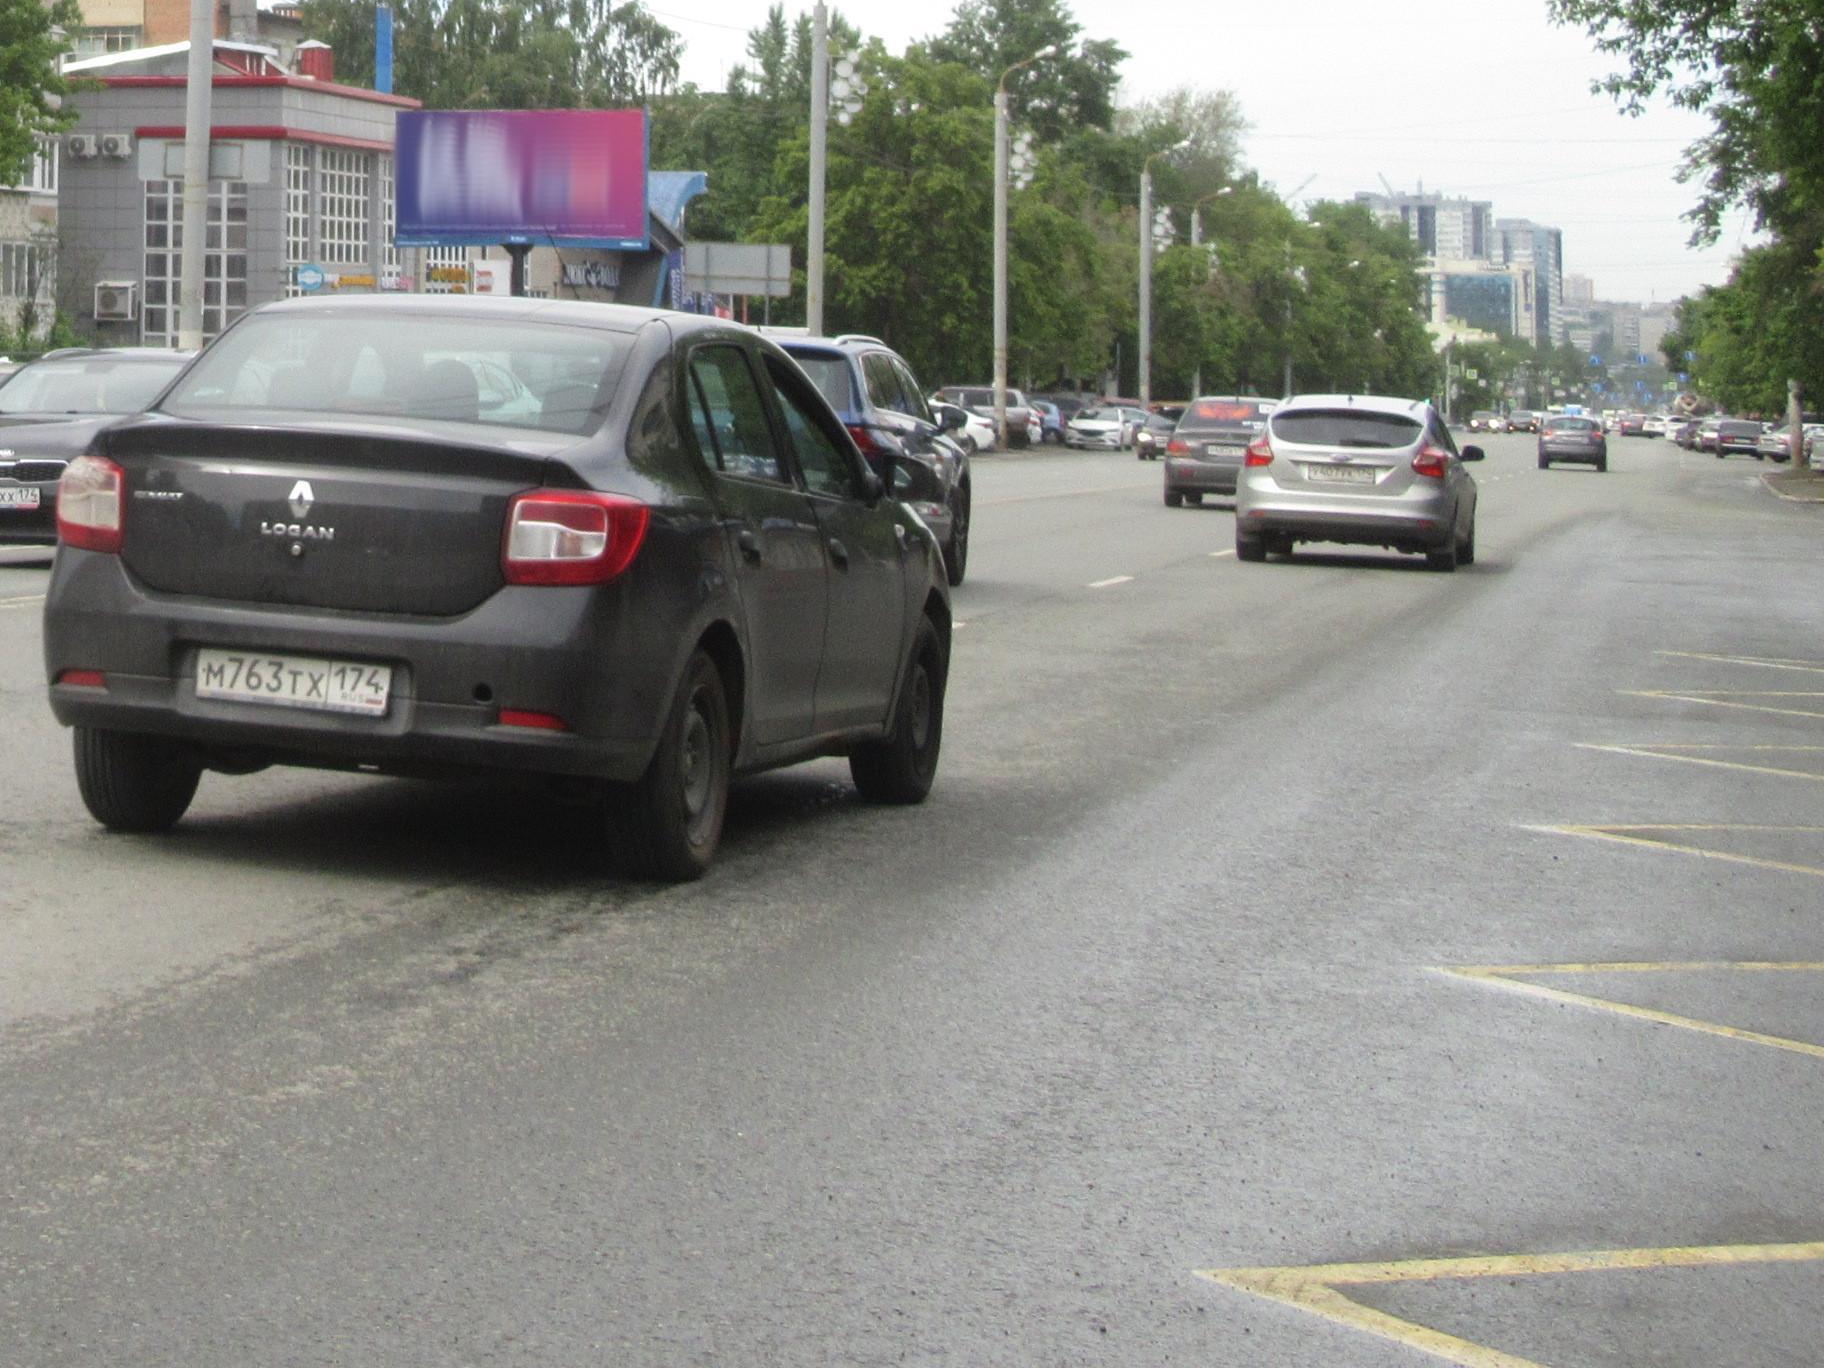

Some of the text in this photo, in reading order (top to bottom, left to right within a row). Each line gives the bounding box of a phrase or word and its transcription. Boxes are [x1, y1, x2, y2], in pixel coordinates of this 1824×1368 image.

[261, 521, 335, 540] LOGAN
[205, 657, 381, 699] М763ТХ 174
